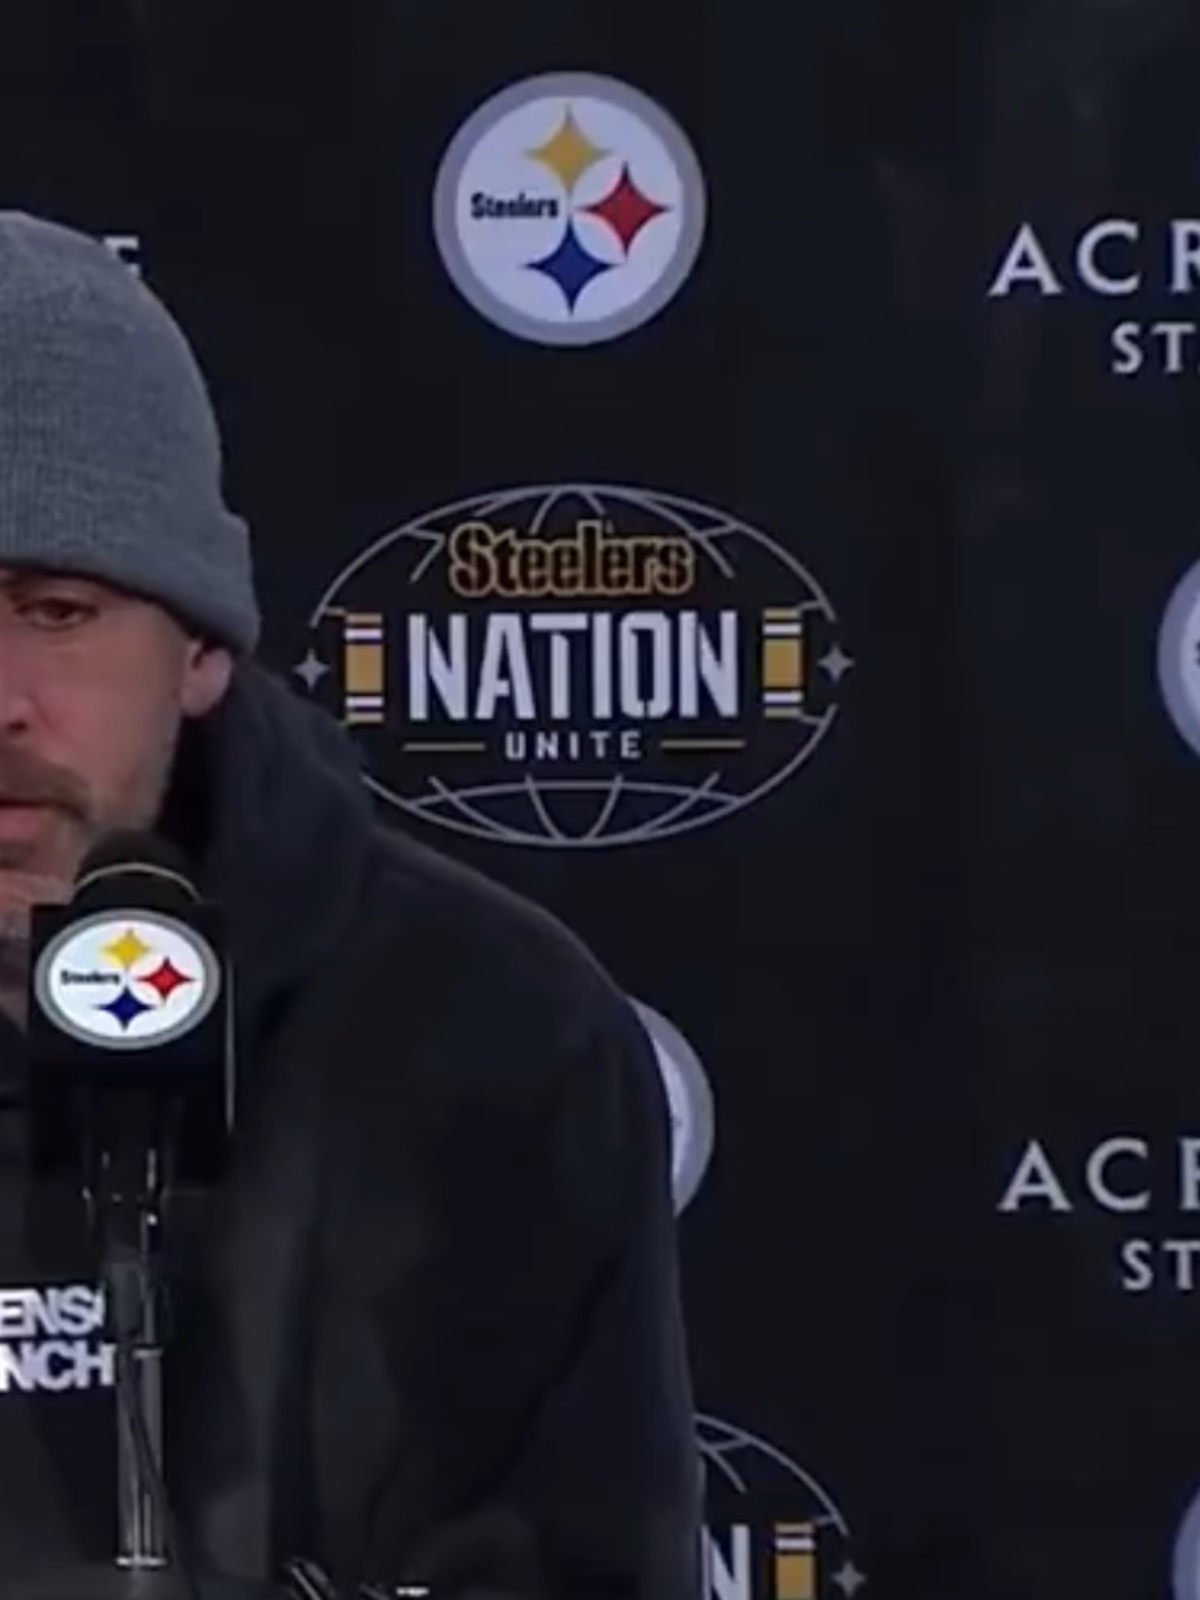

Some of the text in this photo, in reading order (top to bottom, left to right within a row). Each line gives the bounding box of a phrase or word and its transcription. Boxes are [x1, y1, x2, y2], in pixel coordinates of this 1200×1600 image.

[470, 191, 560, 220] Steelers
[448, 520, 695, 597] Steelers
[407, 609, 739, 721] NATION
[504, 730, 642, 760] UNITE
